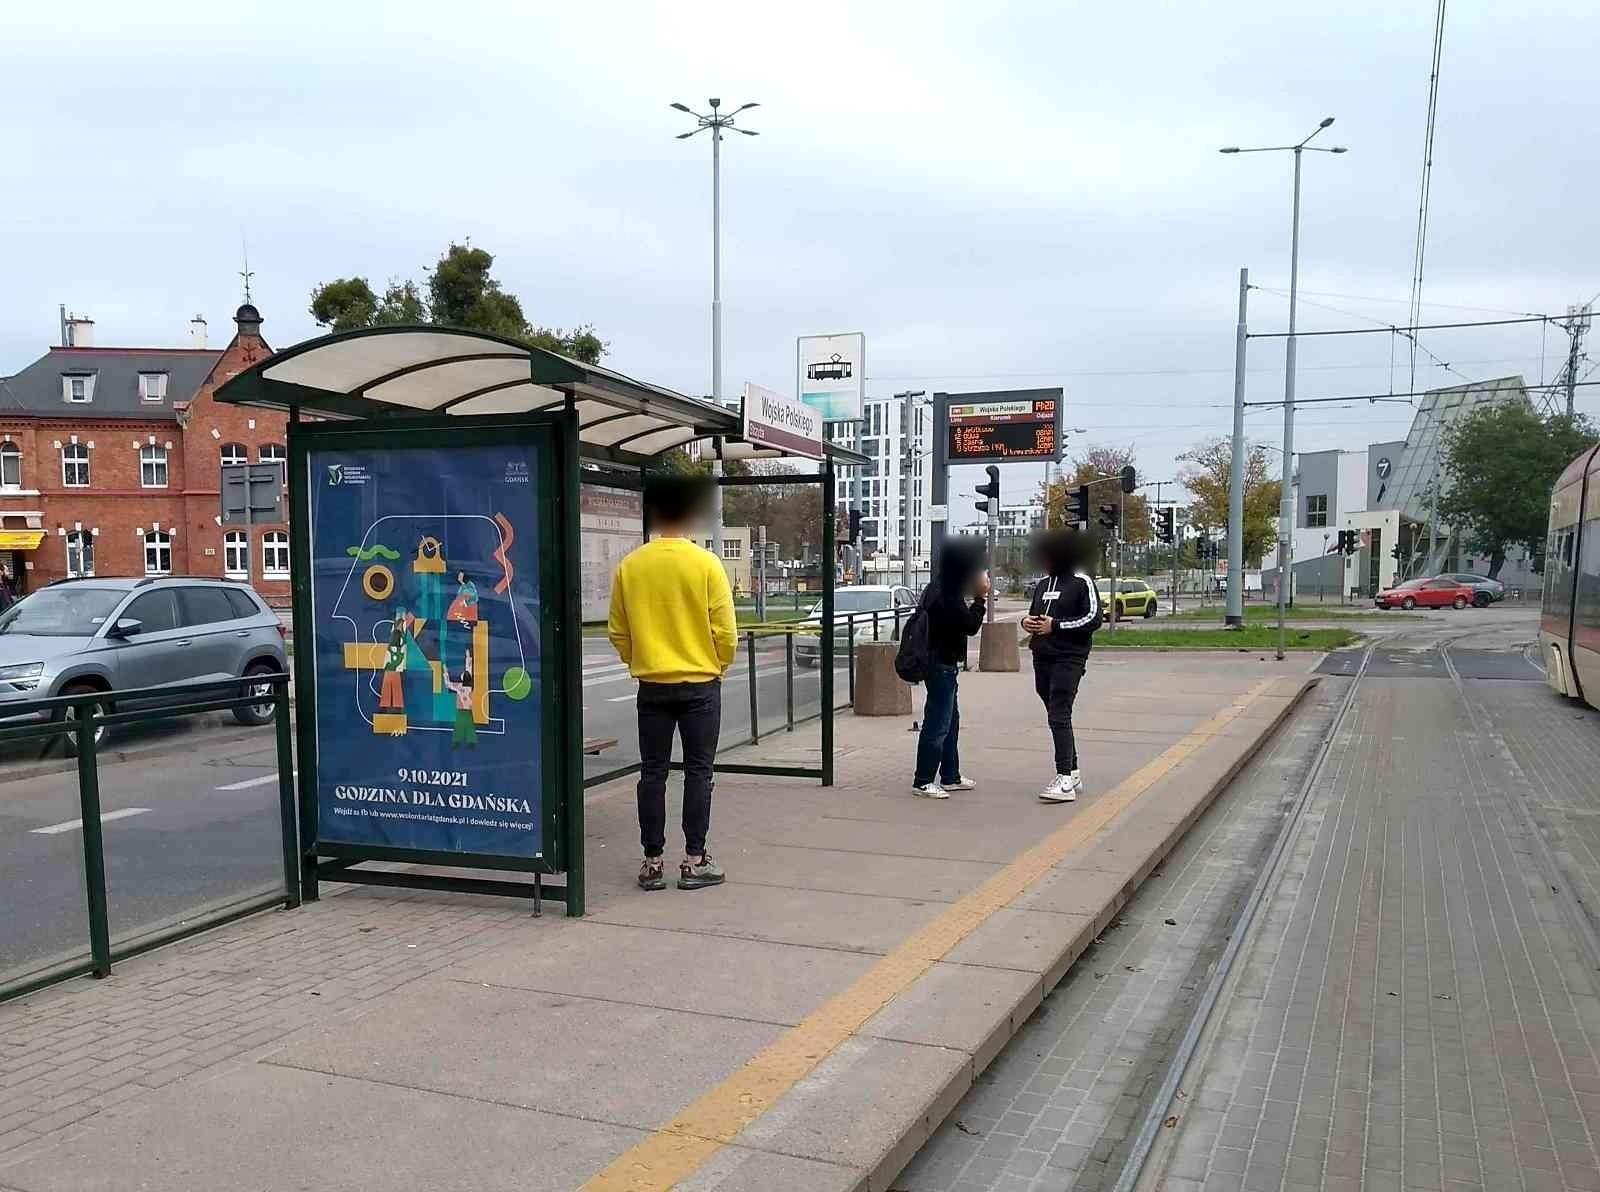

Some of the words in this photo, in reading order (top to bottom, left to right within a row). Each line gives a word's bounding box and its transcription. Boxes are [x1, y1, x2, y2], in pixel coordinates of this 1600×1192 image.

[761, 396, 785, 424] Wojska
[785, 405, 813, 436] Polskiego
[1000, 404, 1026, 412] Polskiego
[398, 768, 467, 786] 9.10.2021
[335, 785, 408, 803] GODZINA
[412, 790, 445, 807] DLA
[448, 793, 531, 813] GDAŃSKA
